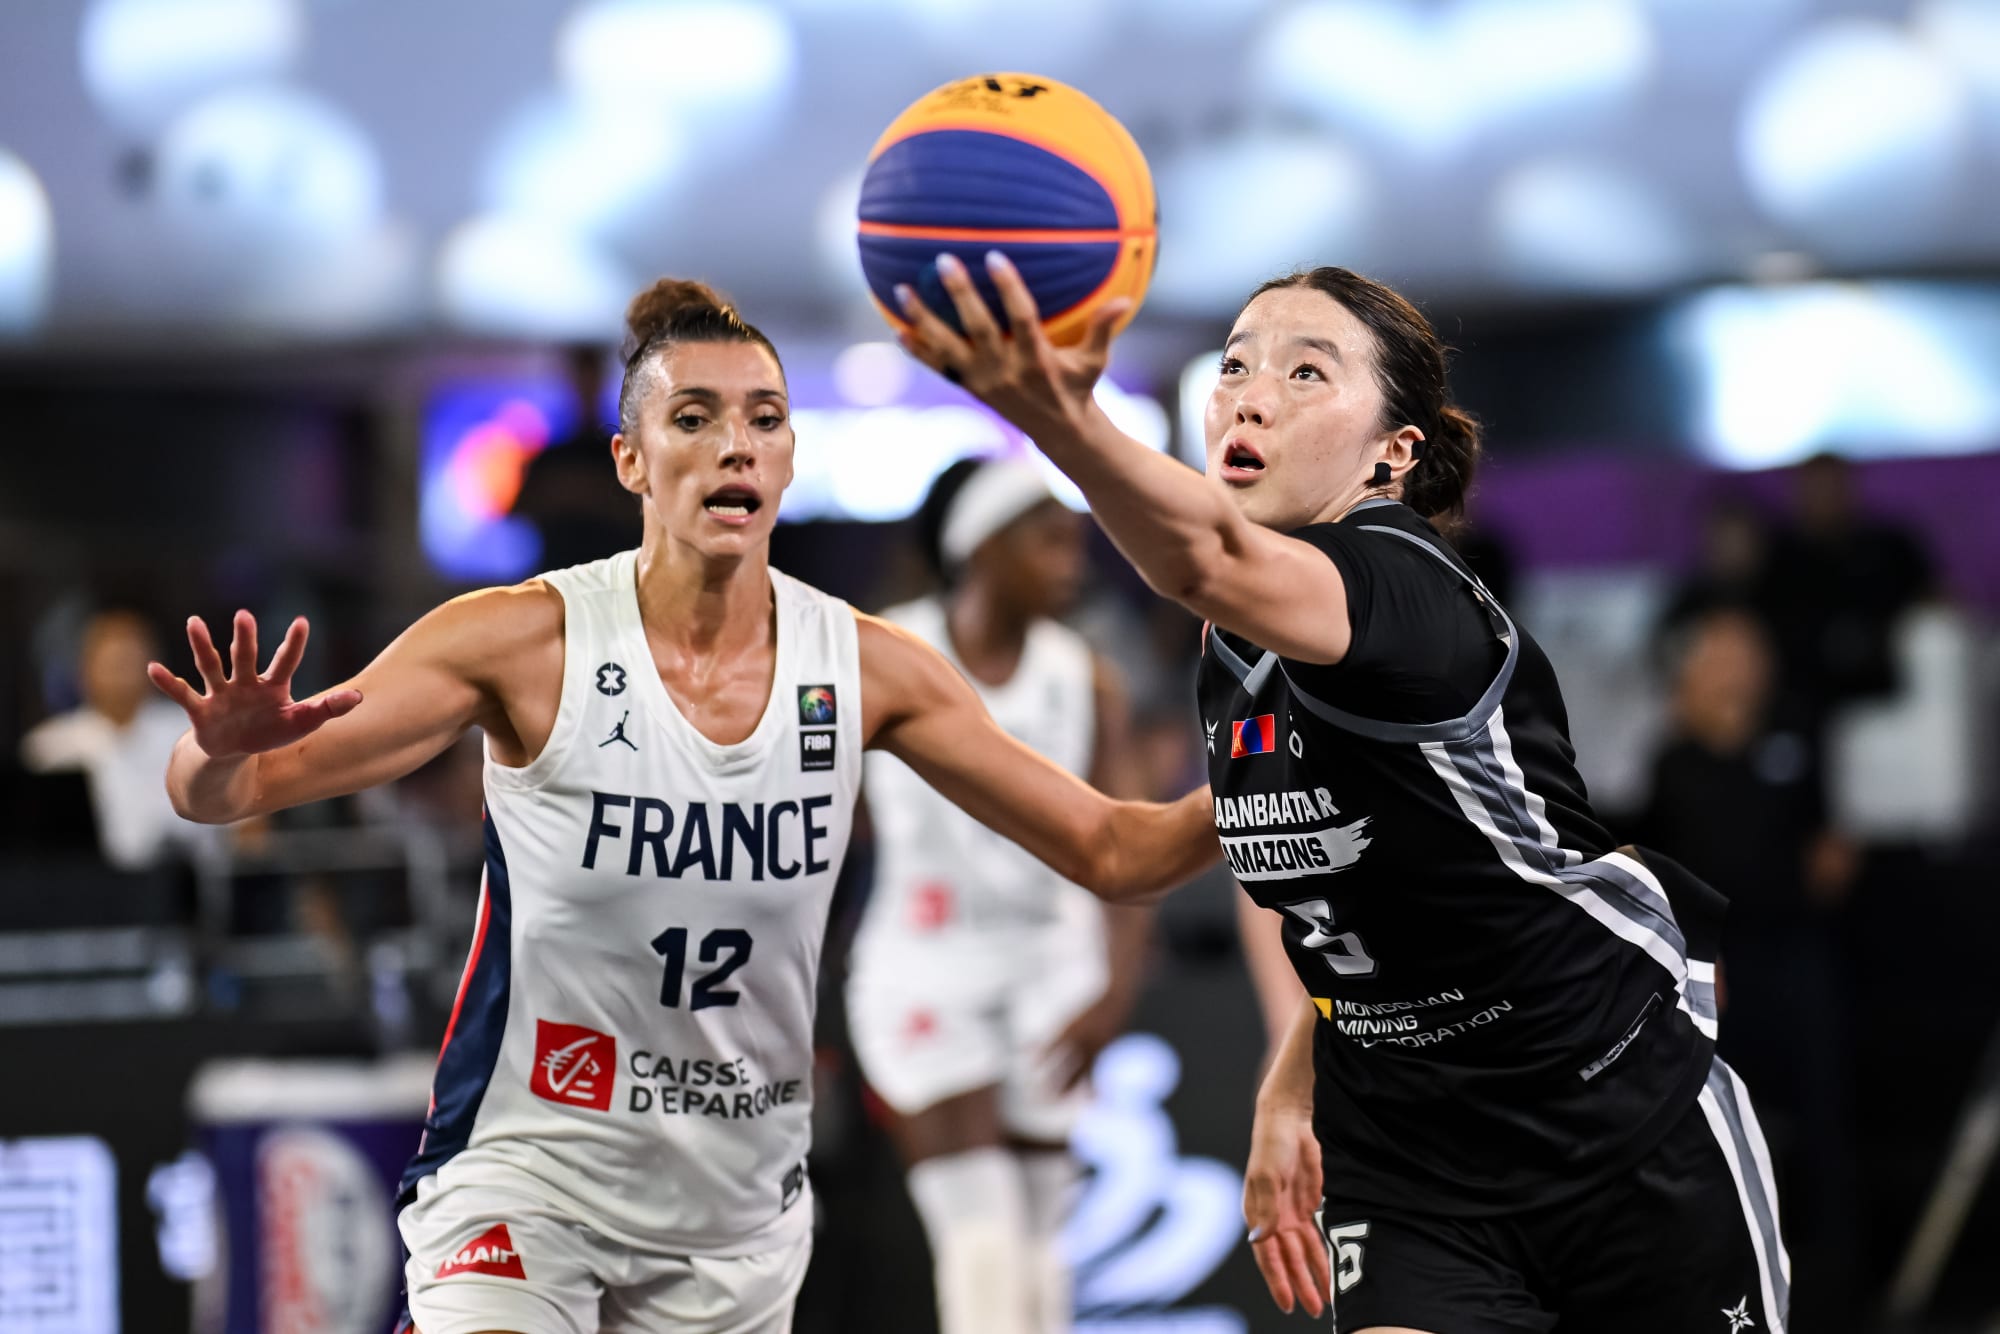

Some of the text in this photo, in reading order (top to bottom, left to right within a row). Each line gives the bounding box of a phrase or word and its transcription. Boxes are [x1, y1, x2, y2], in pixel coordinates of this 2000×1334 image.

[804, 734, 831, 750] FIBA
[581, 791, 832, 881] FRANCE
[651, 927, 753, 1011] 12
[1337, 1015, 1418, 1036] MINING
[630, 1051, 750, 1087] CAISSE
[629, 1079, 801, 1119] D'EPARGNE
